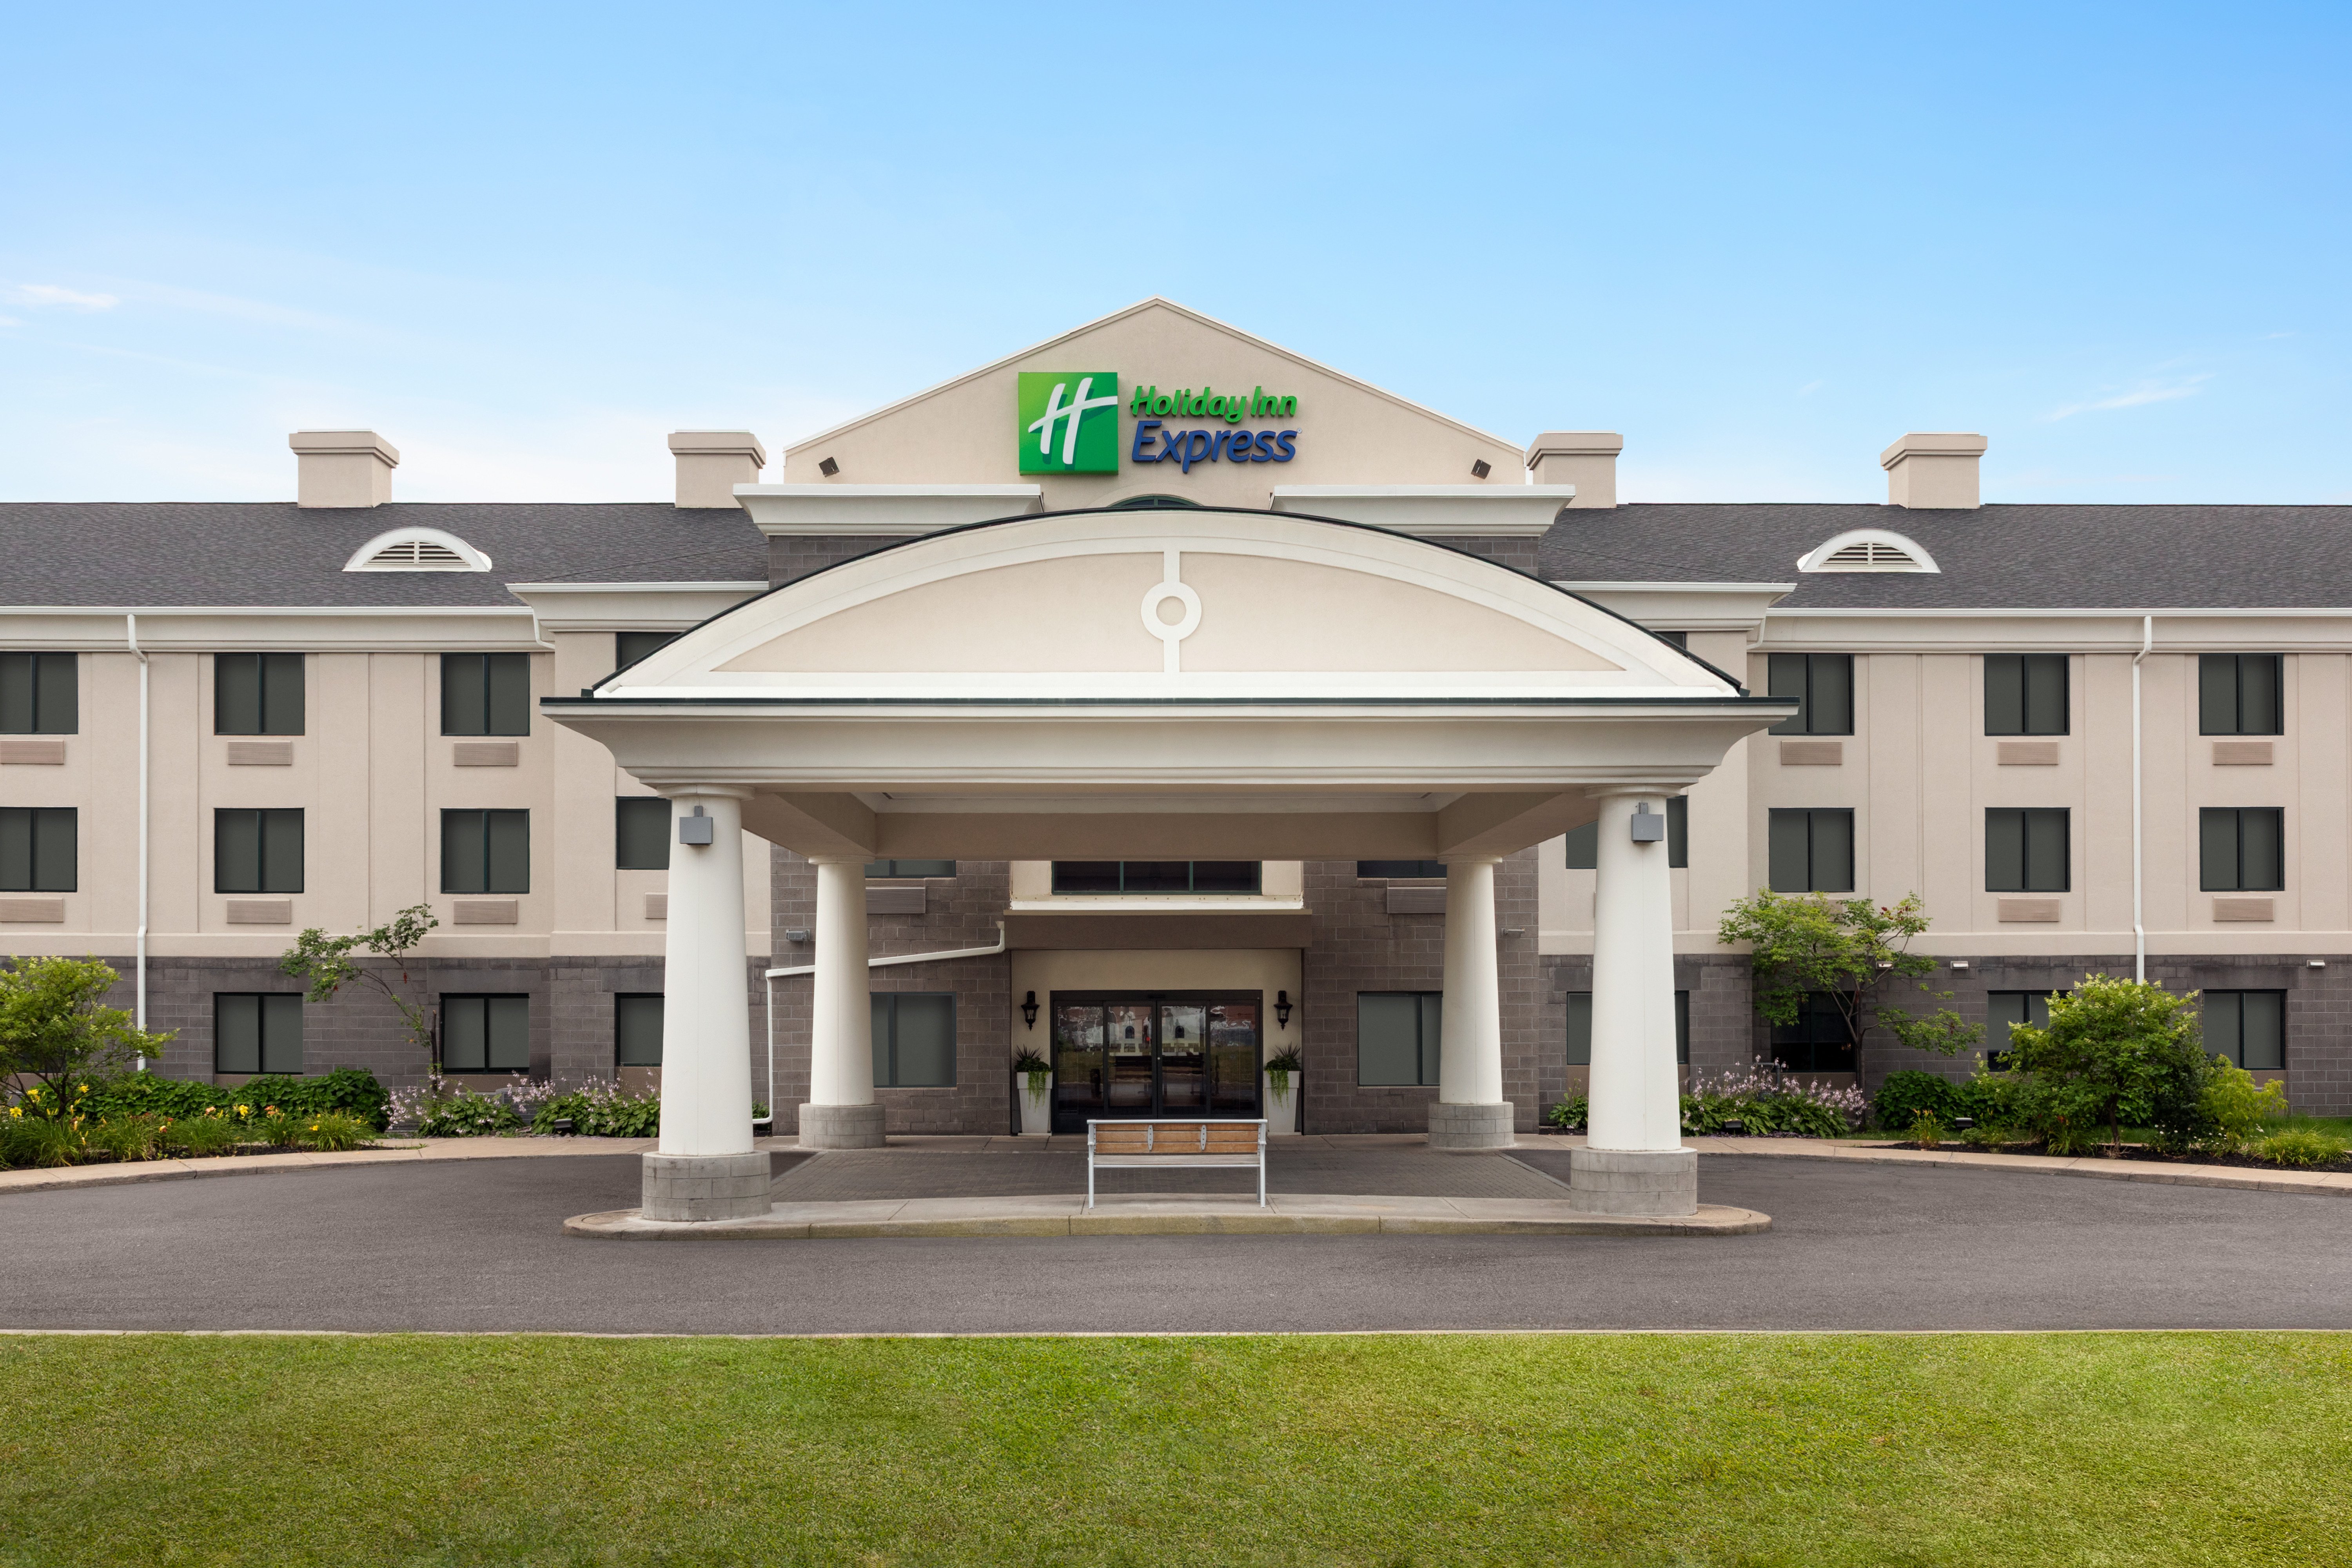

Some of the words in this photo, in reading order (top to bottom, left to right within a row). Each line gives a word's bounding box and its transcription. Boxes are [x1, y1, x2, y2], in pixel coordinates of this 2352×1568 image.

[1028, 377, 1118, 464] H
[1130, 386, 1247, 423] Holiday
[1250, 386, 1297, 416] Inn
